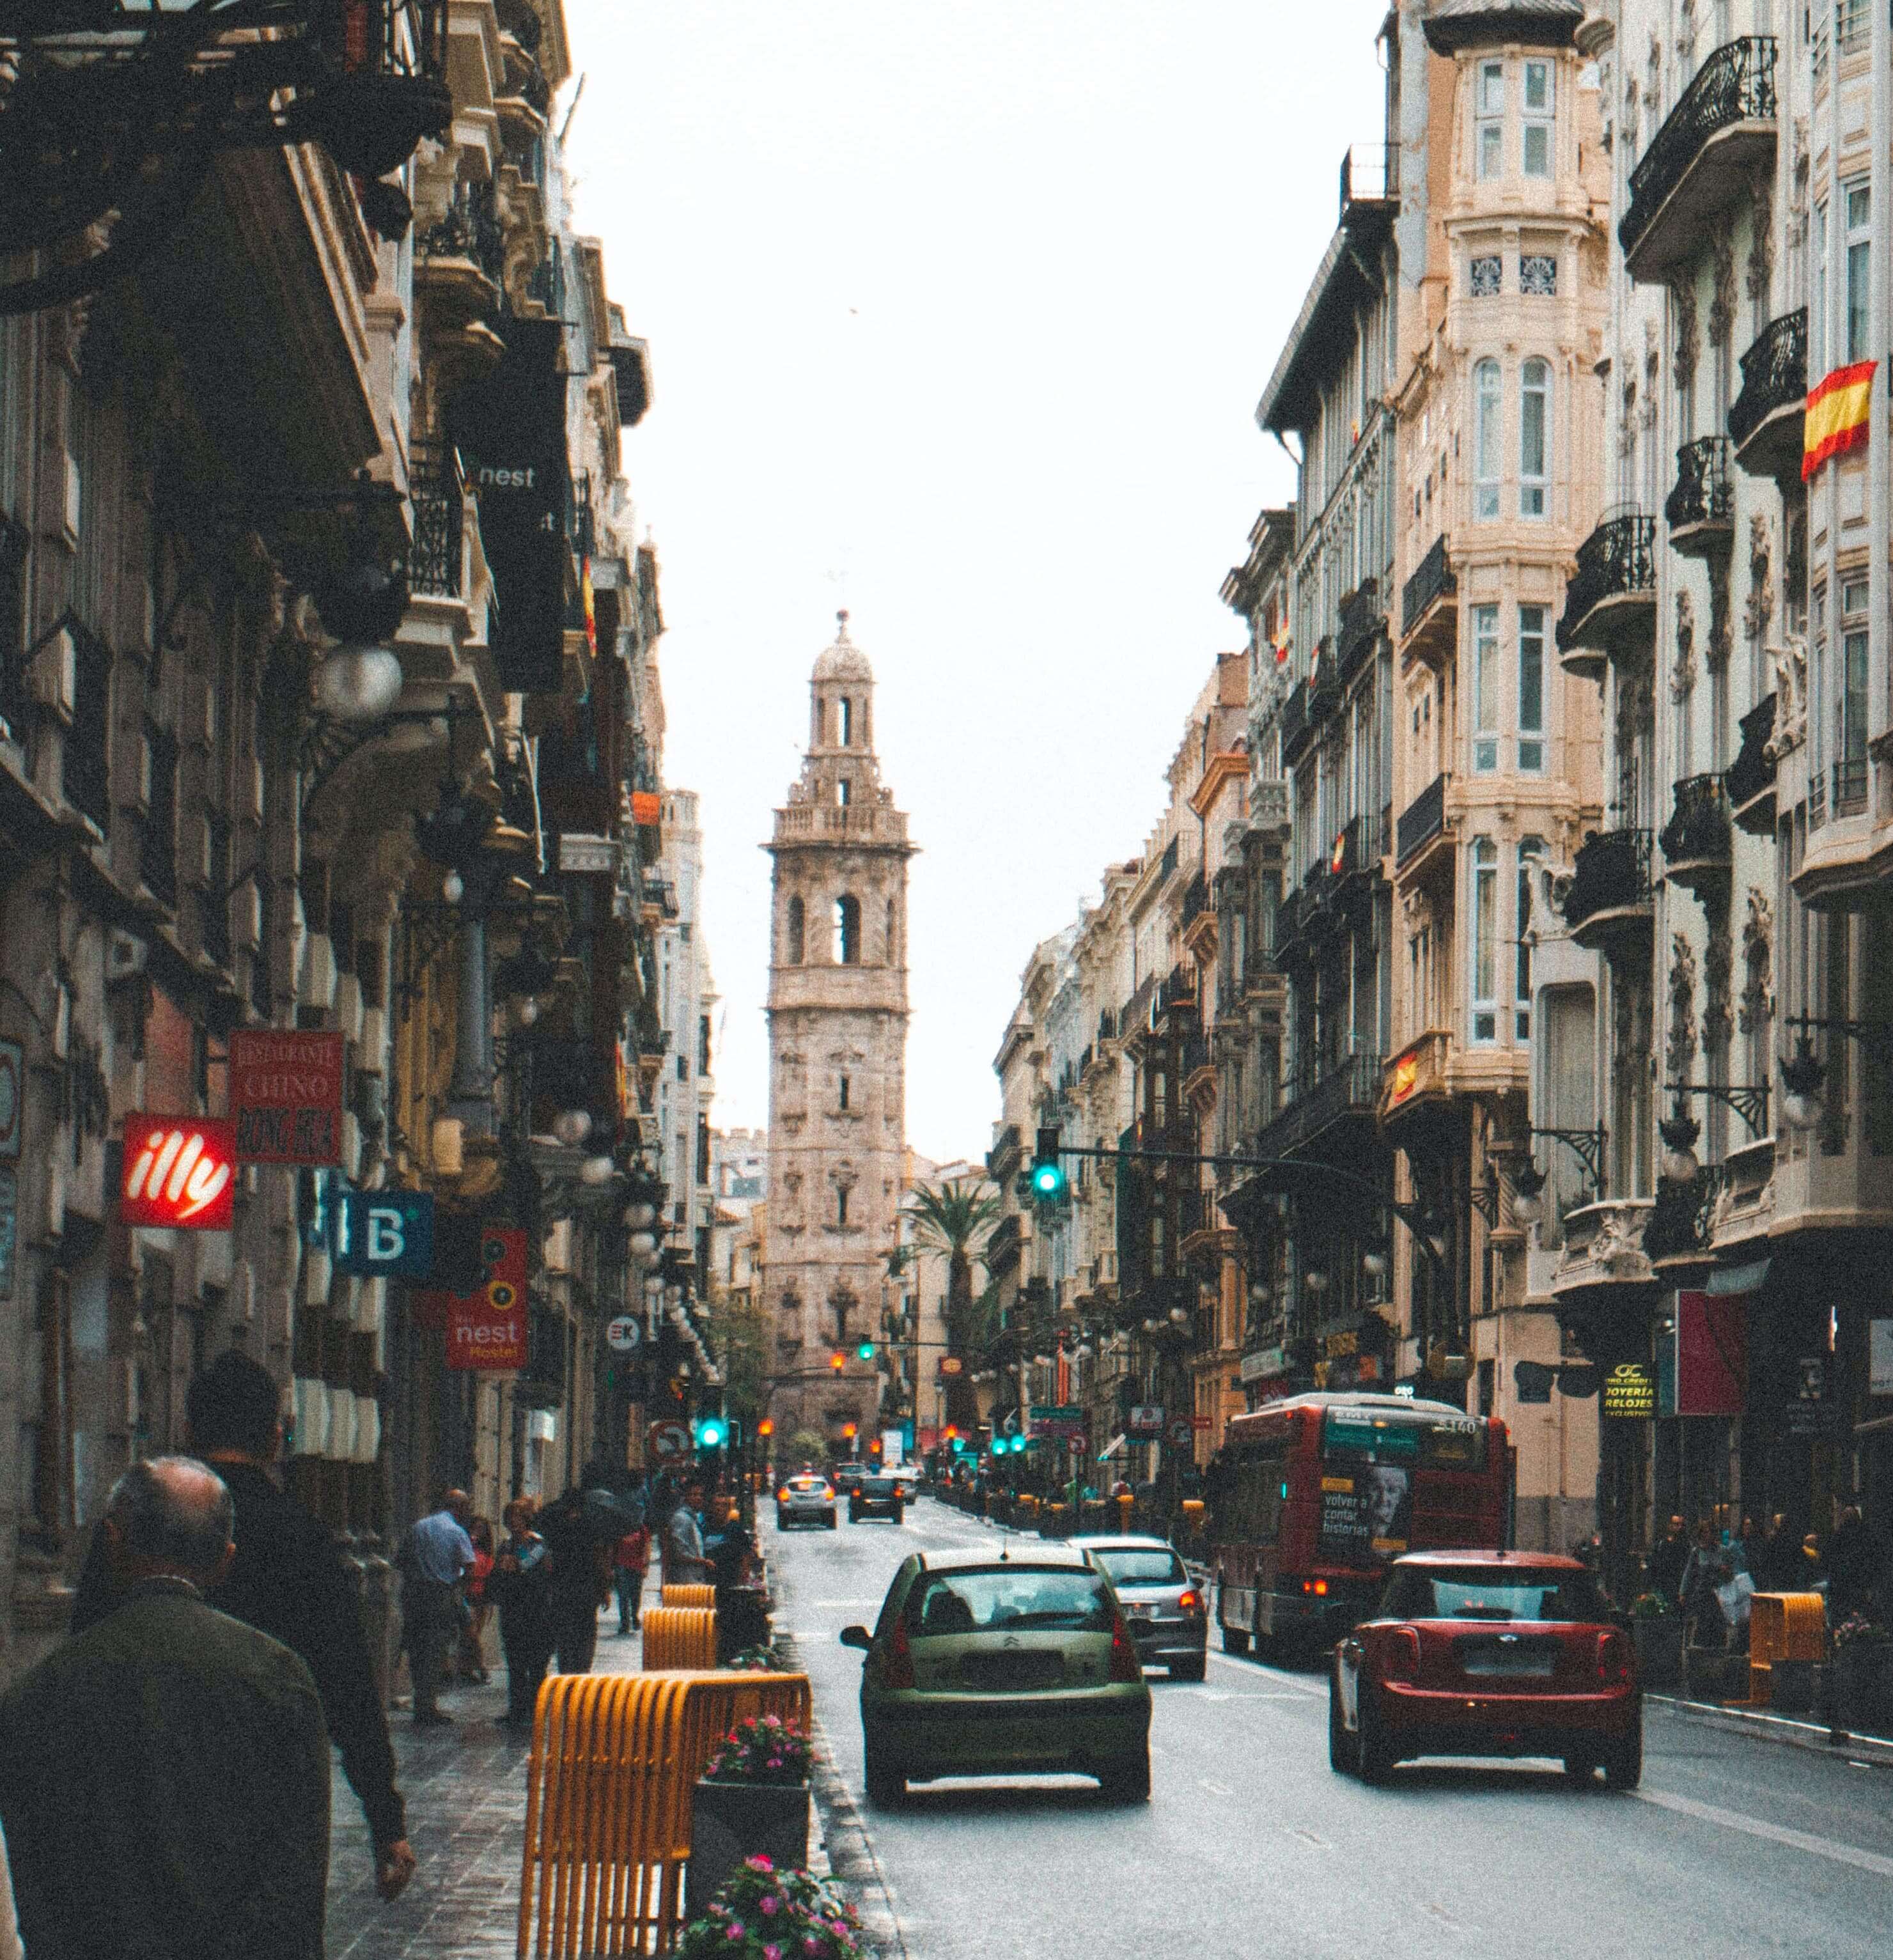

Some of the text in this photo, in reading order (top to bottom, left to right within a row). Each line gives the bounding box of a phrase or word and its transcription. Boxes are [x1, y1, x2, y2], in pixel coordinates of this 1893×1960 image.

[479, 467, 534, 488] nest
[245, 1073, 329, 1098] CHINO
[127, 1130, 230, 1220] illy
[456, 1321, 519, 1344] nest
[1606, 1386, 1654, 1396] JOYERÍA
[1605, 1399, 1653, 1408] RELOJES
[1325, 1493, 1367, 1509] volver a
[1324, 1508, 1358, 1521] contar
[1323, 1520, 1368, 1536] historias
